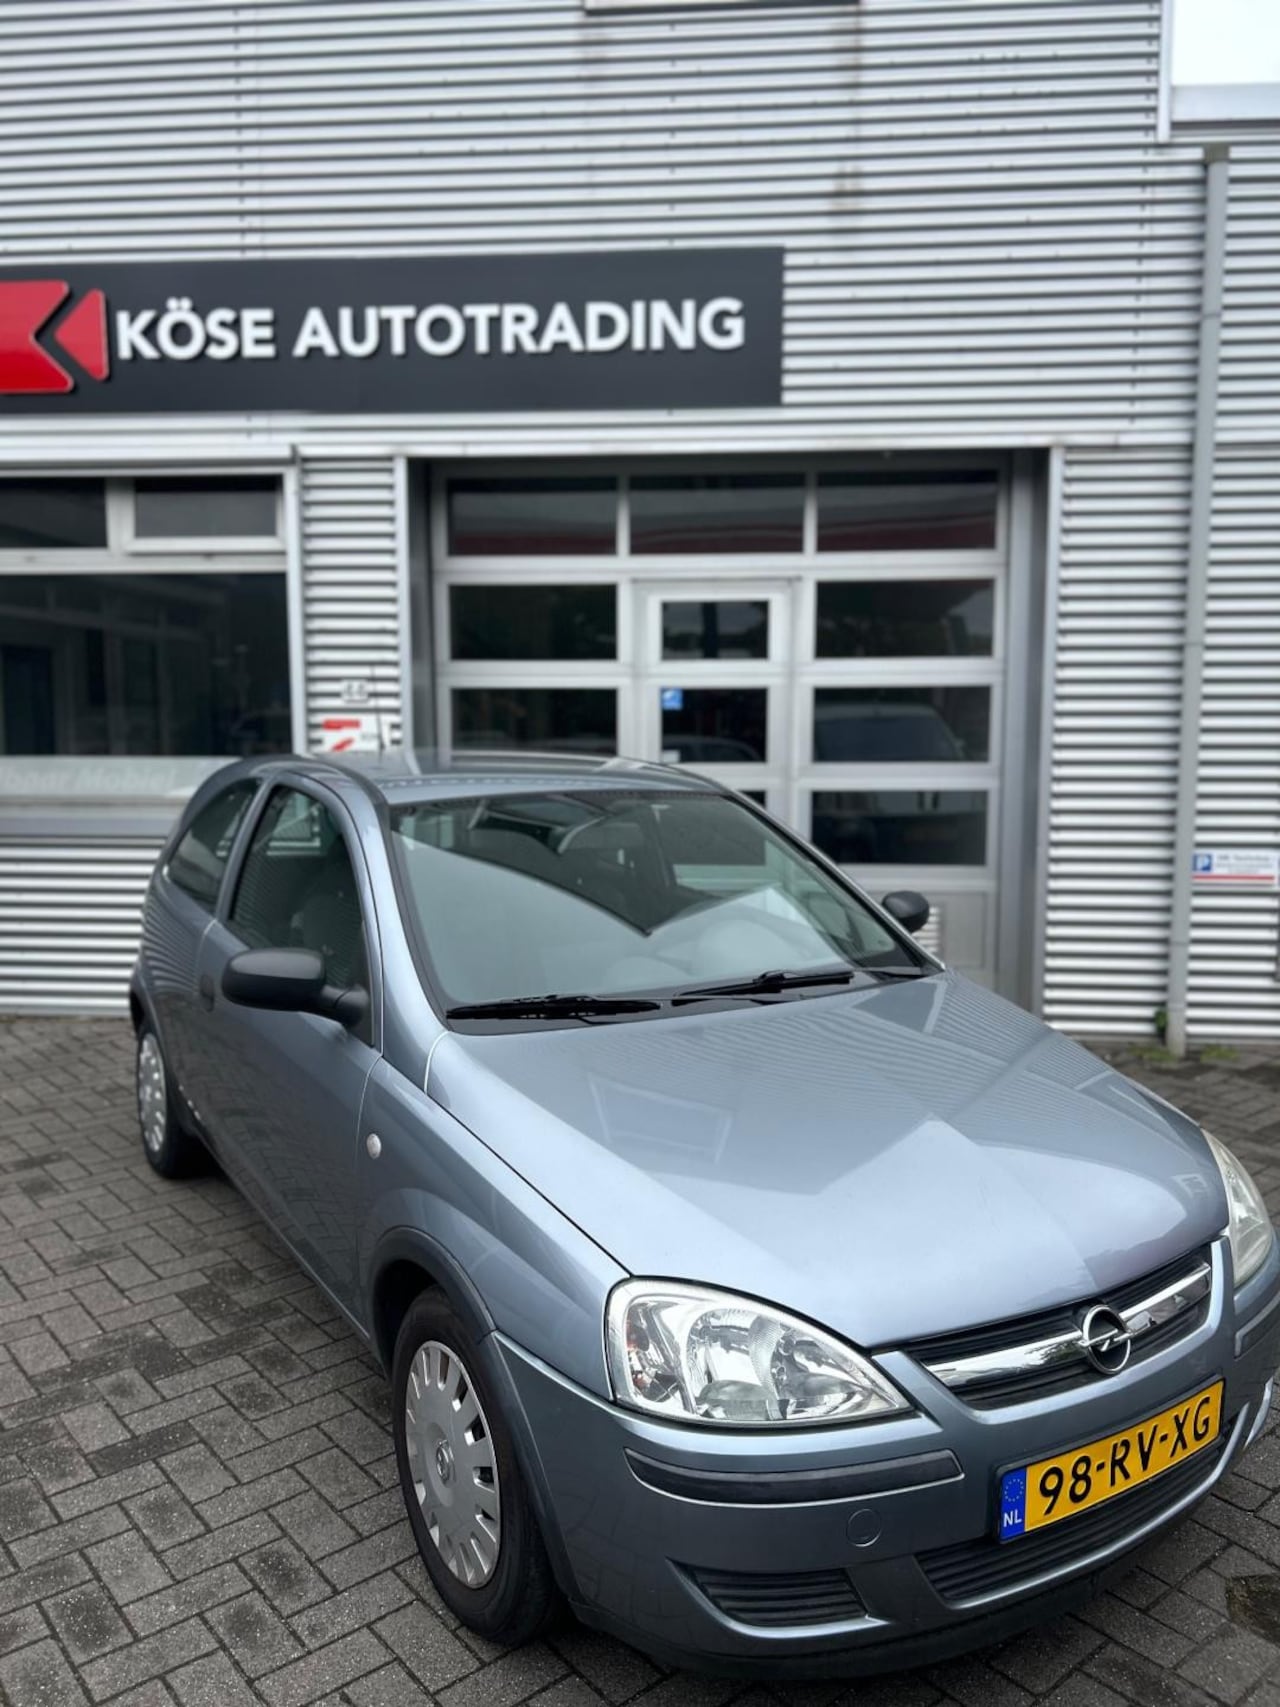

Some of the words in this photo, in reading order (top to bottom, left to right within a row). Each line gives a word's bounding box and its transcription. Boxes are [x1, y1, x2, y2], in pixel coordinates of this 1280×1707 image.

[116, 297, 274, 360] KÖSE
[293, 297, 745, 358] AUTOTRADING
[1039, 1396, 1210, 1516] 98-RV-XG
[1003, 1509, 1022, 1528] NL
